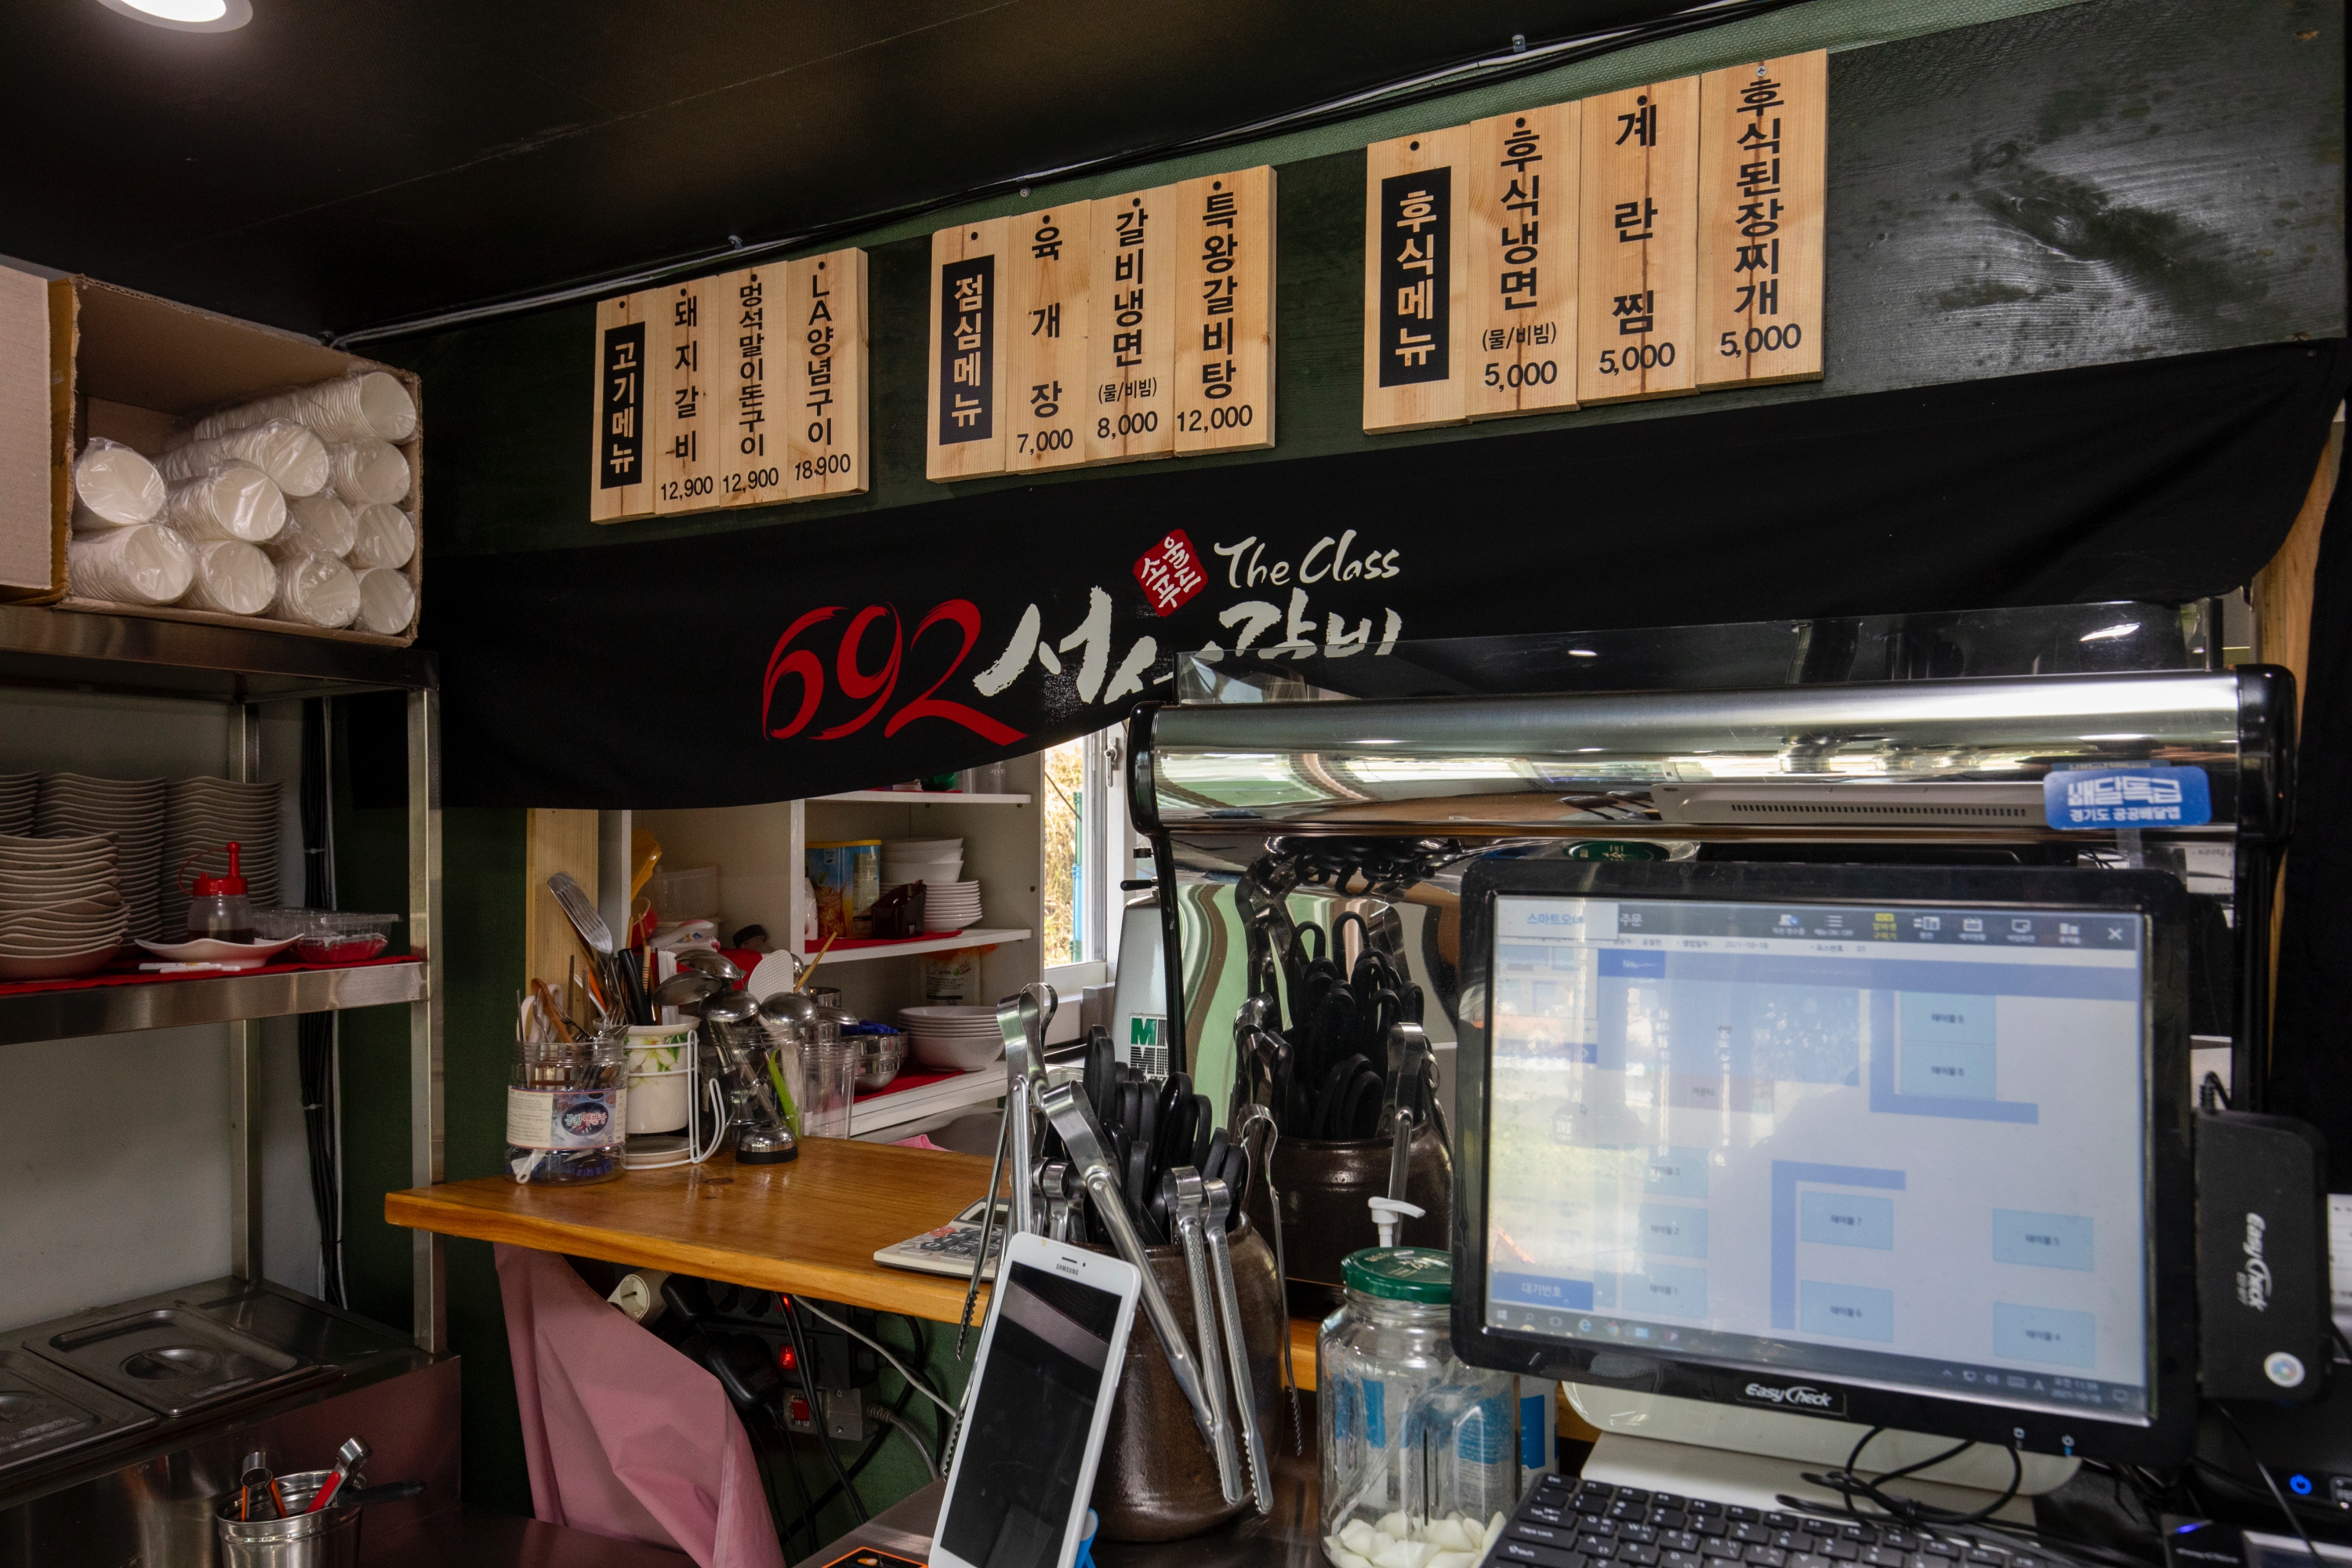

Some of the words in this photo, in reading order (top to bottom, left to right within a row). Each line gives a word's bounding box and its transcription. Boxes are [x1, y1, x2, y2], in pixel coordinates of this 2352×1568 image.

[1733, 78, 1784, 315] 후식된장찌개
[1500, 129, 1543, 311] 후식냉면
[1612, 103, 1658, 336] 계란찜
[1113, 208, 1149, 368] 갈비냉면
[1201, 191, 1238, 400] 특왕갈비탕
[1395, 190, 1437, 367] 후식메뉴
[1030, 226, 1062, 419] 육개장
[1482, 321, 1557, 352] (물/비빔)
[952, 274, 983, 427] 점심메뉴
[1719, 322, 1802, 358] 5,000
[739, 282, 764, 456] 멍석말이돈구이
[806, 274, 834, 445] LA양념구이
[1483, 360, 1558, 391] 5,000
[1598, 342, 1675, 375] 5,000
[674, 296, 699, 462] 돼지갈비
[1098, 377, 1157, 404] (물/비빔)
[610, 342, 637, 474] 고기메뉴
[1177, 405, 1253, 434] 12,000
[1017, 428, 1073, 456] 7,000
[1097, 411, 1158, 440] 8,000
[723, 466, 779, 493] 12,900
[795, 453, 851, 481] 18,900
[661, 475, 713, 501] 12,900
[1214, 536, 1290, 588] The
[1299, 529, 1400, 586] Class
[762, 599, 1028, 746] 692
[2067, 775, 2183, 806] 배달특급
[2070, 808, 2111, 822] 경기도
[1055, 1263, 1080, 1276] SAMSUNG
[1521, 1282, 1563, 1298] 대기번호
[1745, 1382, 1833, 1407] EasyCheck
